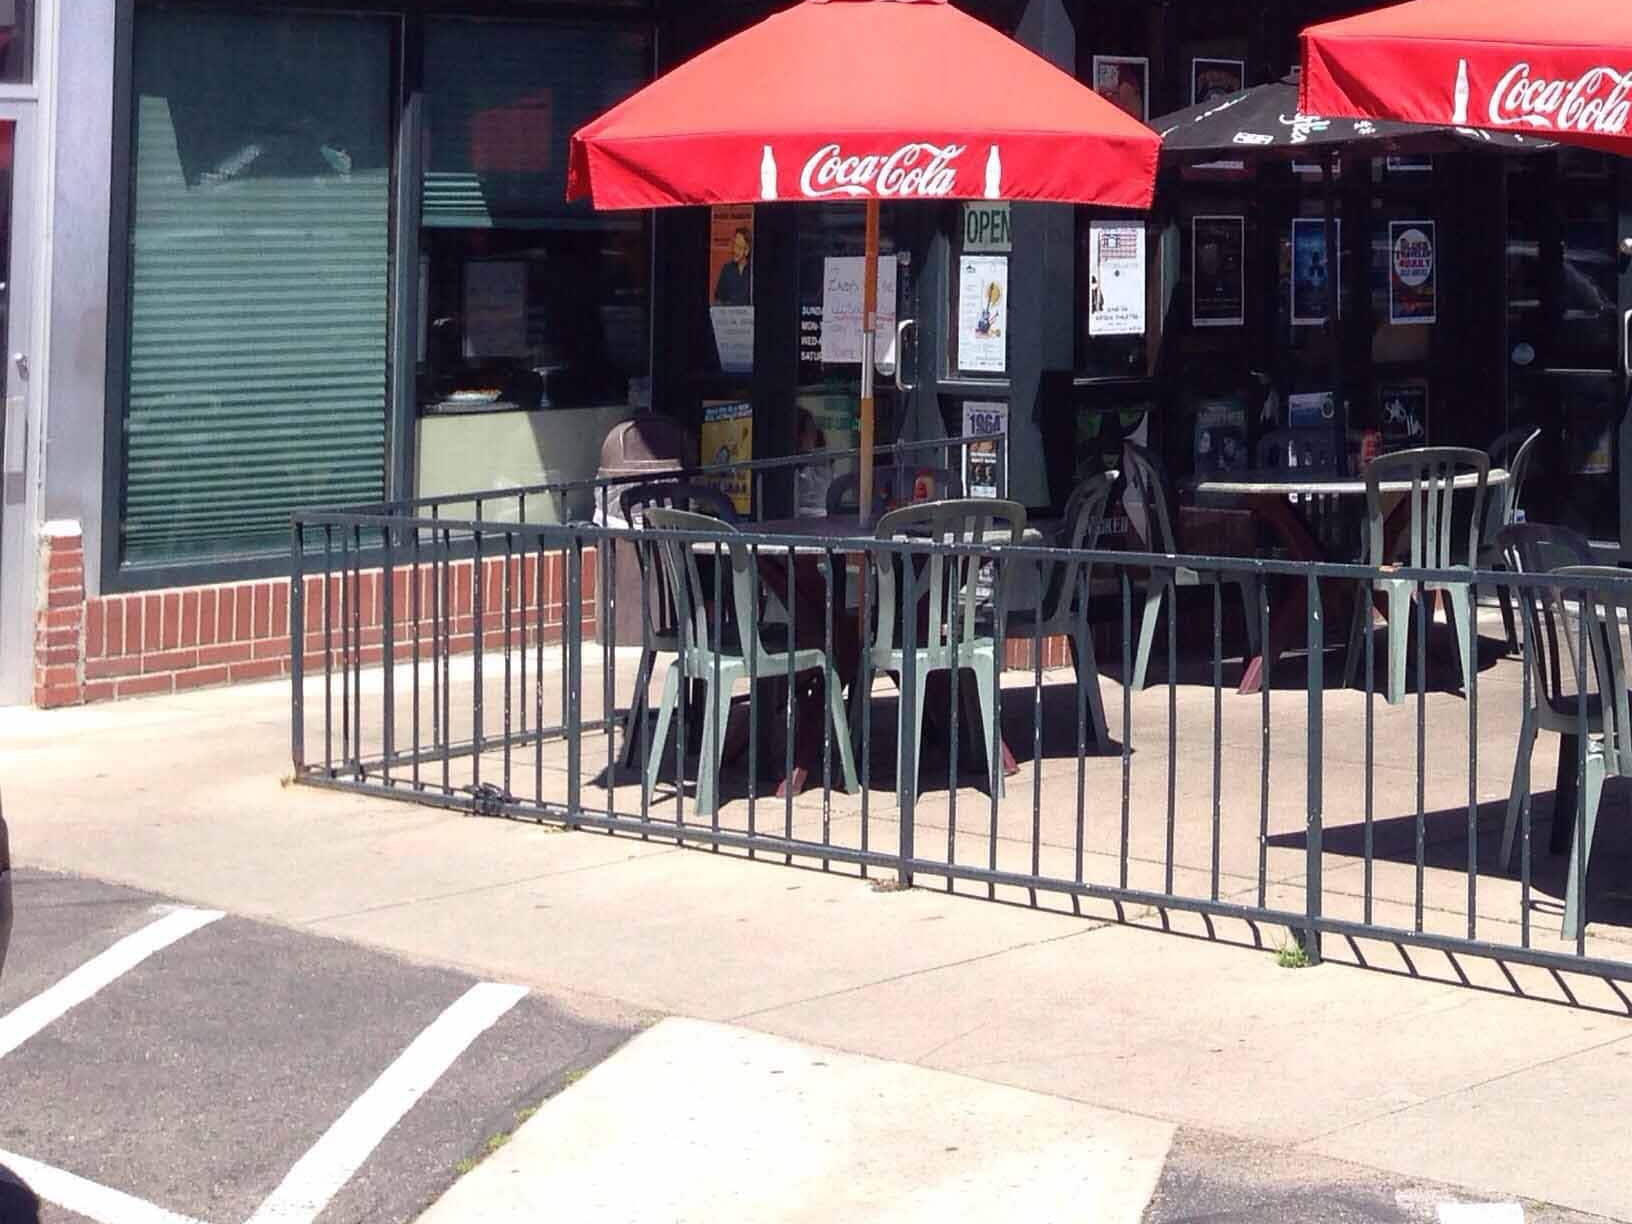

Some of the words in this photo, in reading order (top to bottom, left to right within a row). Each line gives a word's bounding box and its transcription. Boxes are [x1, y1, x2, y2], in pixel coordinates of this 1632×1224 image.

[800, 144, 967, 197] Coca-Cola
[966, 209, 1010, 244] OPEN
[801, 305, 823, 316] SUND
